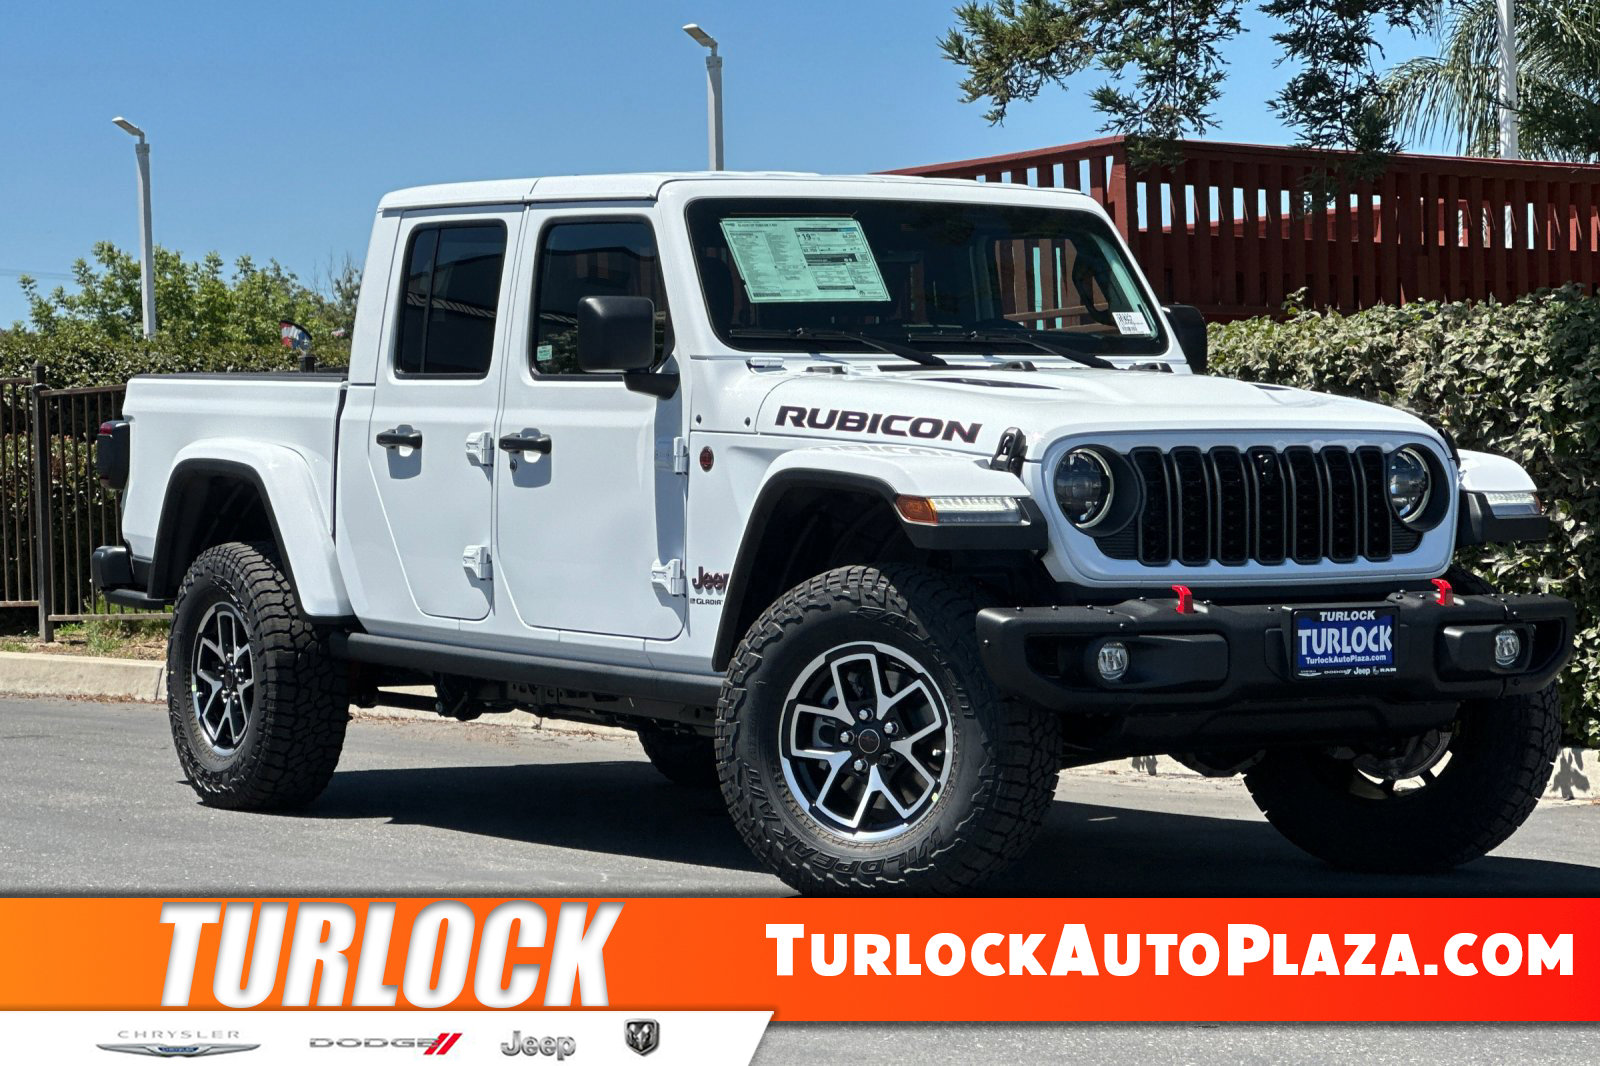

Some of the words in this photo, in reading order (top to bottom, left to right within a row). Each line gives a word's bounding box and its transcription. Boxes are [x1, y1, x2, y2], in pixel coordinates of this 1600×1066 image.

[775, 405, 983, 443] RUBICON
[1319, 610, 1376, 622] TURLOCK
[1297, 625, 1393, 656] TURLOCK
[1305, 654, 1387, 665] TurlockAutoPlaza.com
